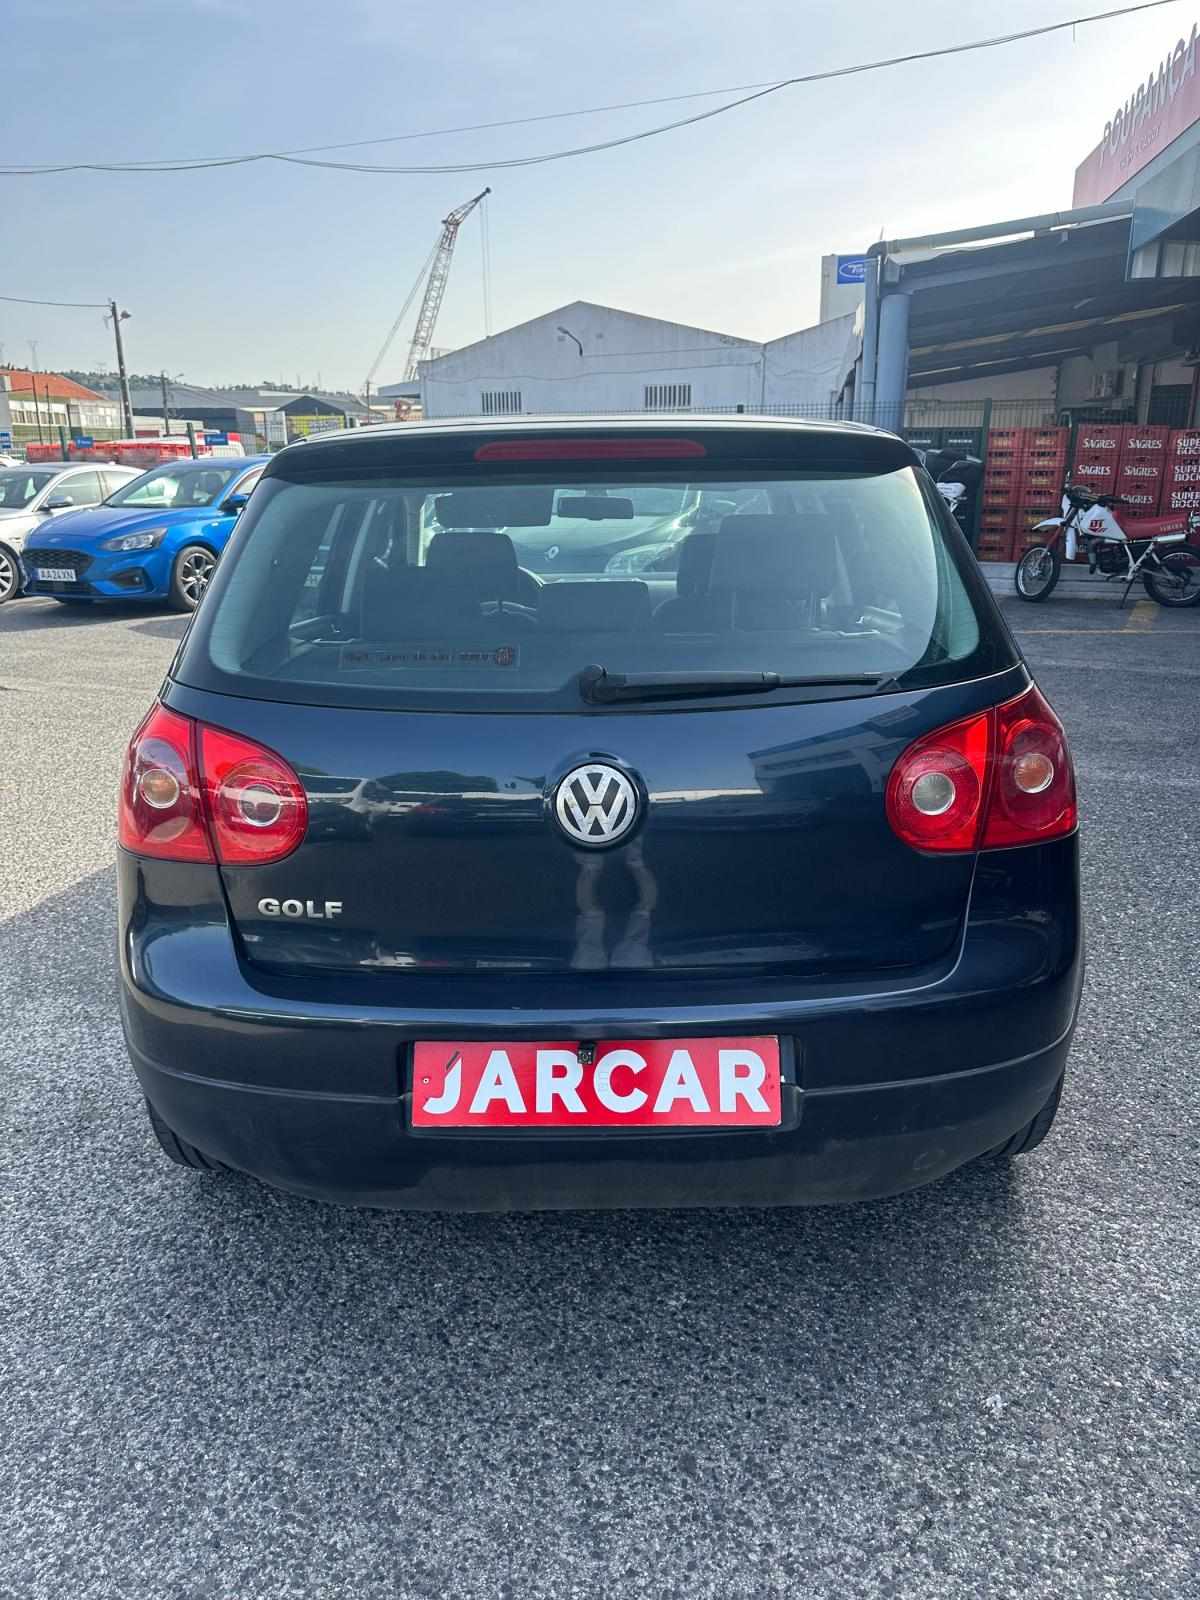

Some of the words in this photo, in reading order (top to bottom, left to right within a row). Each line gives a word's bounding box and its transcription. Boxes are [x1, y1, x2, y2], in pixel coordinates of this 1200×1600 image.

[1082, 438, 1116, 449] SAGRES
[1128, 438, 1162, 449] SAGRES
[1078, 464, 1111, 475] SAGRES
[1124, 465, 1158, 476] SAGRES
[257, 897, 343, 919] GOLF
[422, 1048, 771, 1114] JARCAR
